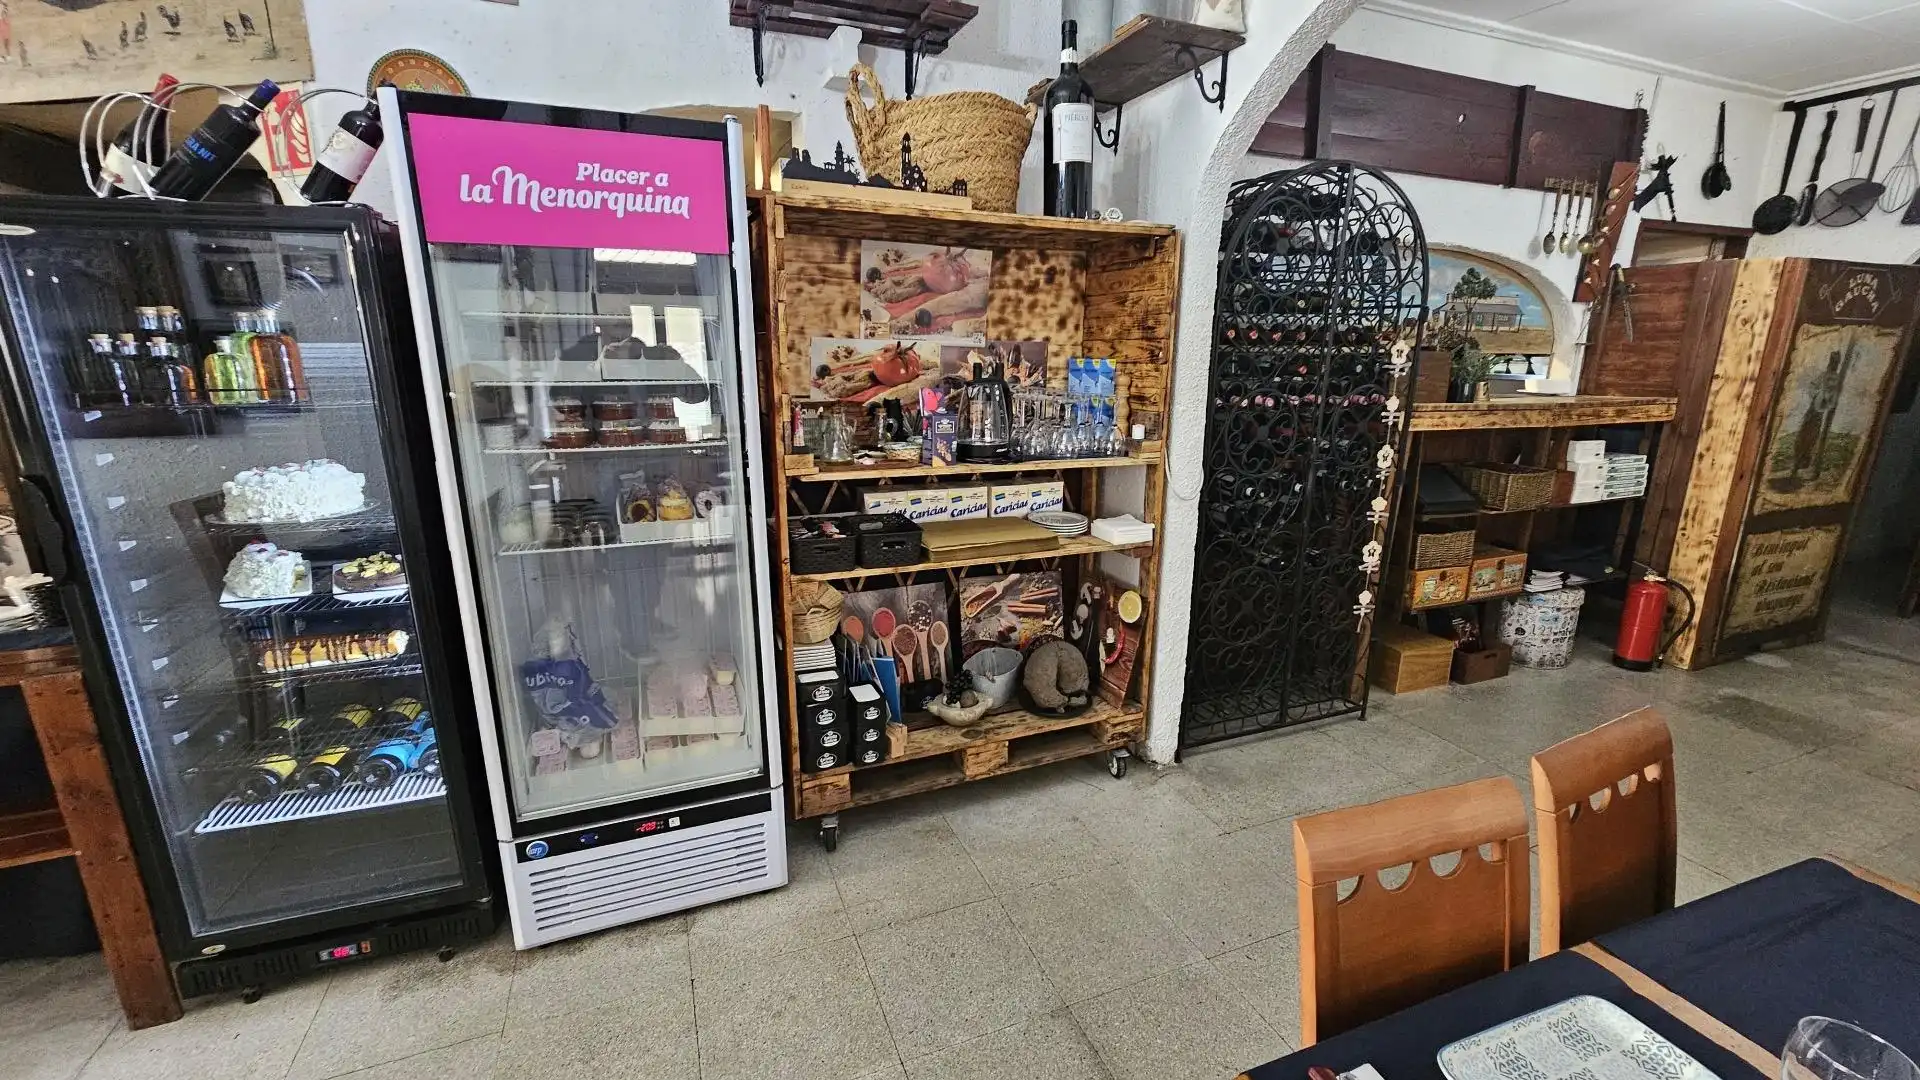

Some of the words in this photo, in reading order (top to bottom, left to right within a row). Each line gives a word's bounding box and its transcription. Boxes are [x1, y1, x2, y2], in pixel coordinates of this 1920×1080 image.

[576, 162, 649, 186] Placer
[655, 172, 669, 187] a
[459, 174, 494, 204] la
[491, 165, 690, 219] Menorquina
[1849, 273, 1878, 290] LUNA
[909, 505, 948, 520] Caricias
[949, 502, 987, 518] Caricias
[993, 499, 1029, 515] Caricias
[1030, 497, 1063, 512] Caricias
